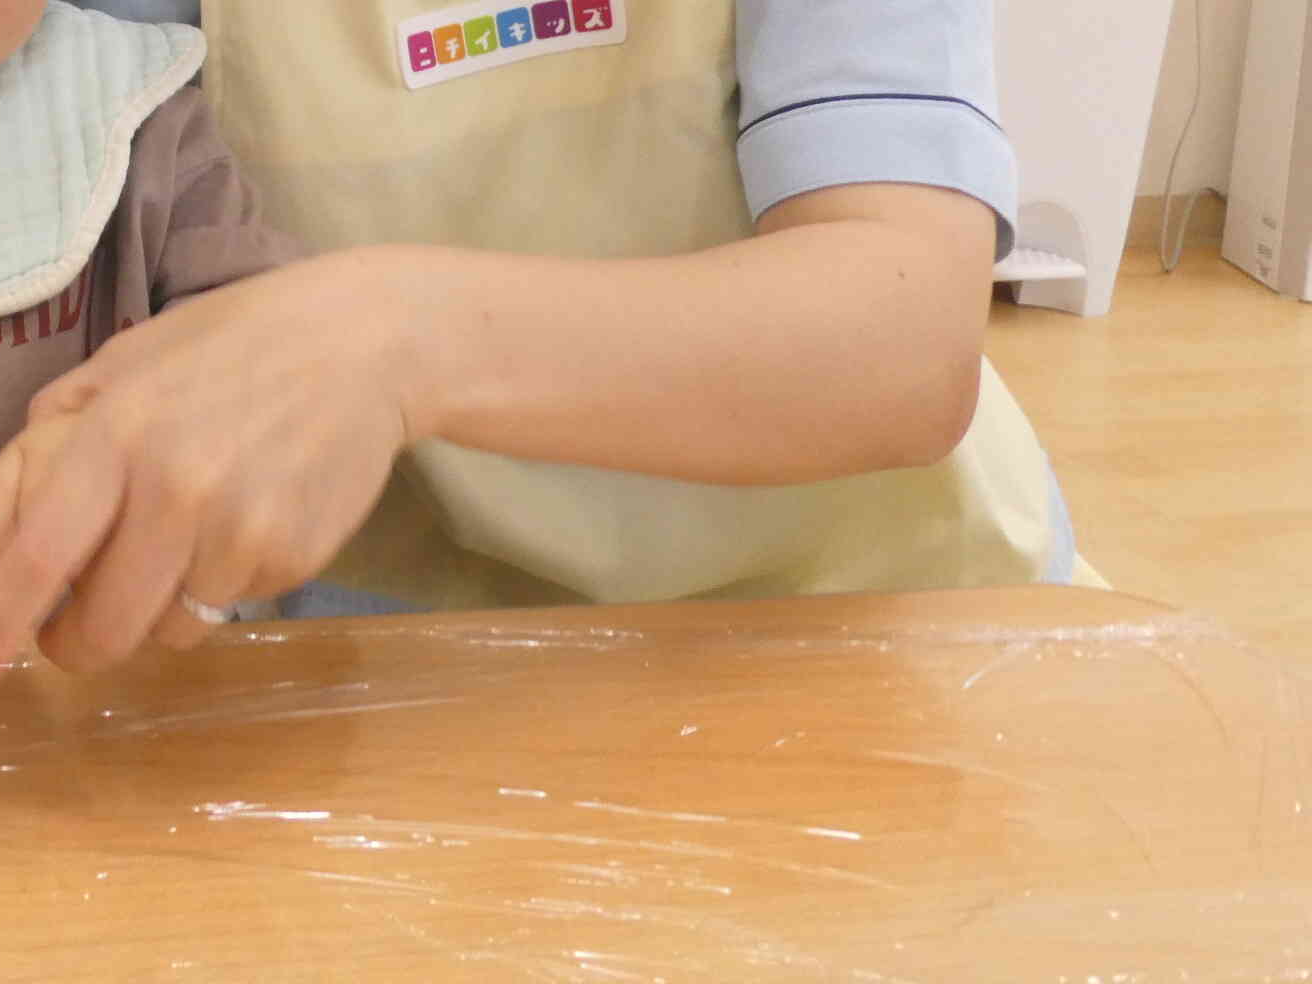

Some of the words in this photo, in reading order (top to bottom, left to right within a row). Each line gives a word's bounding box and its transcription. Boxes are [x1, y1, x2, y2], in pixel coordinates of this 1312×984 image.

[417, 4, 610, 68] ニチイキッズ
